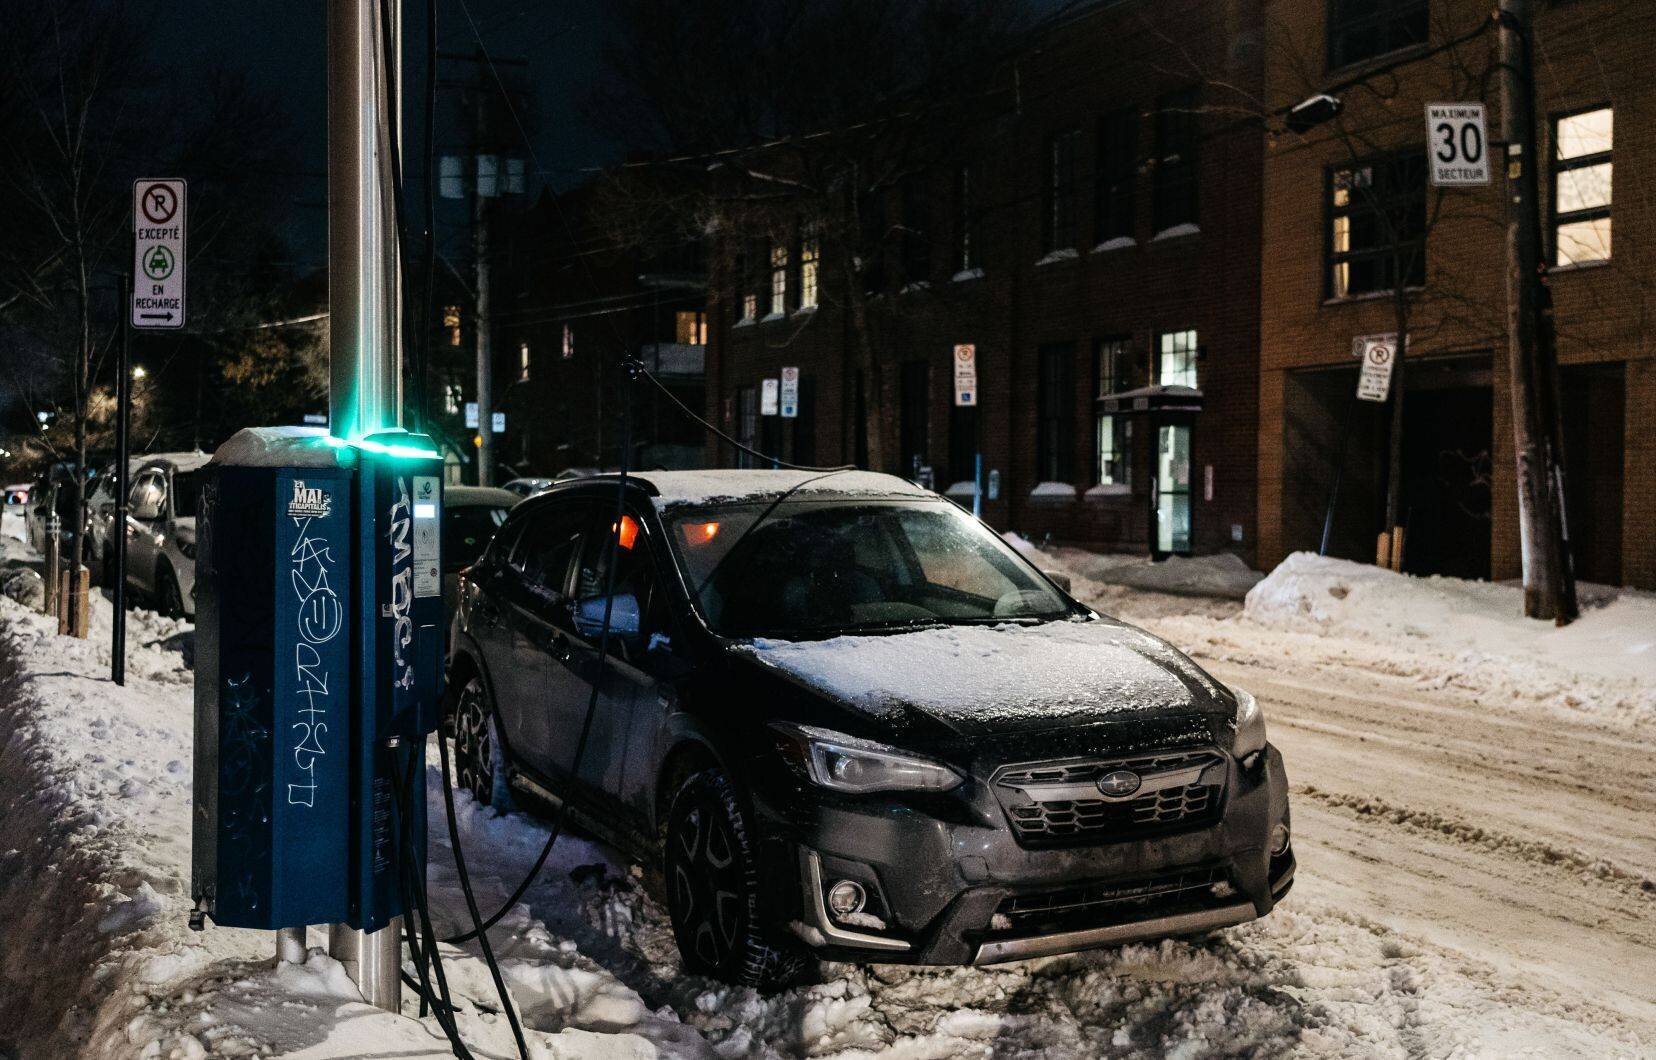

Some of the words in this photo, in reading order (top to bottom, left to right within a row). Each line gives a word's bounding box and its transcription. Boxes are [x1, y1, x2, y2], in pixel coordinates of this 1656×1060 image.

[1431, 109, 1480, 119] MAXIMUM
[1436, 122, 1482, 163] 30
[1438, 168, 1483, 180] SECTEUR
[138, 226, 180, 240] EXCEPTÉ
[152, 285, 164, 296] EN
[135, 297, 180, 309] RECHARGE
